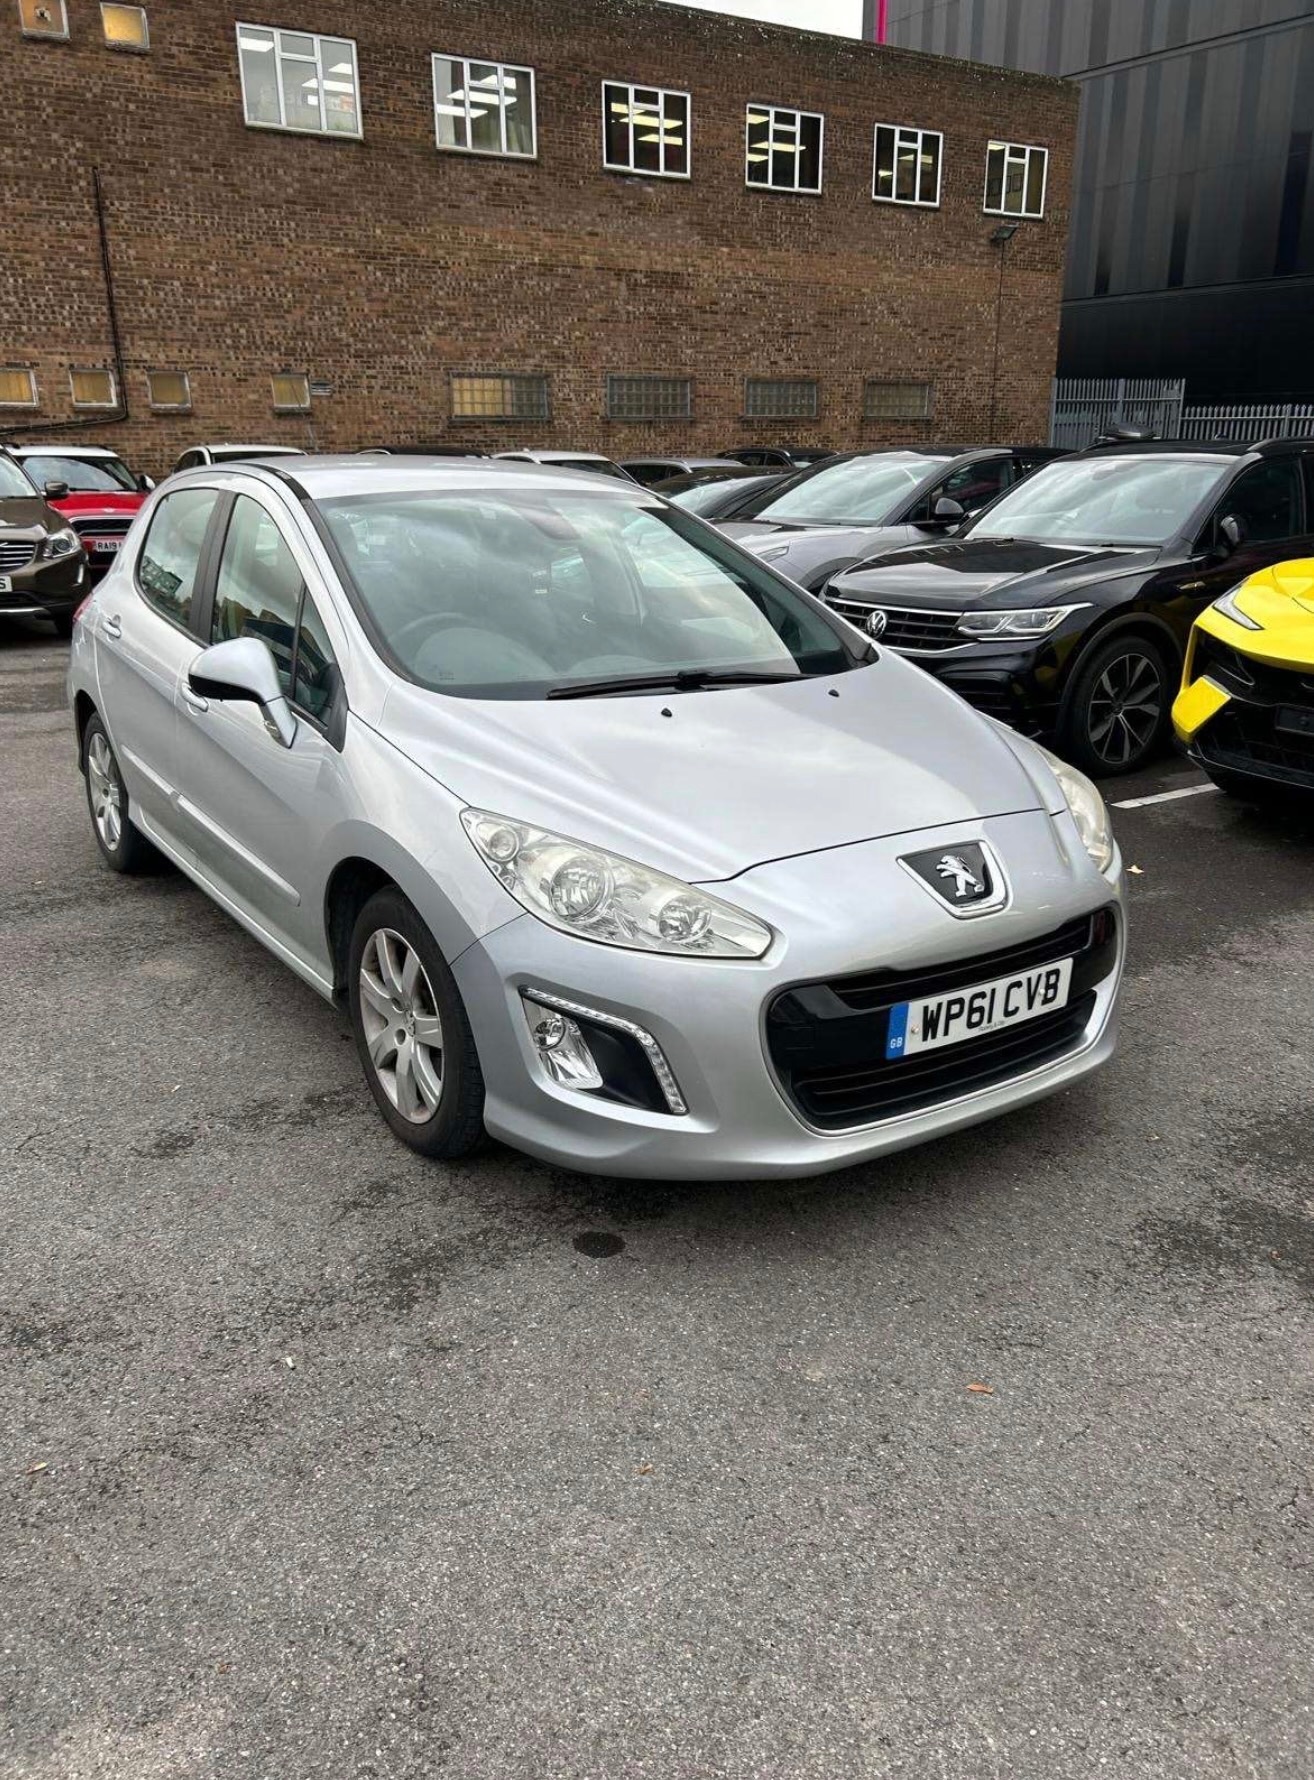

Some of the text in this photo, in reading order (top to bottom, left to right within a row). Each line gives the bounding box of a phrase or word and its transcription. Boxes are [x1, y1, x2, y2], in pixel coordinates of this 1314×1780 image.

[97, 542, 117, 550] RA19
[922, 968, 1061, 1042] WP61 CVB
[890, 1036, 903, 1049] GB
